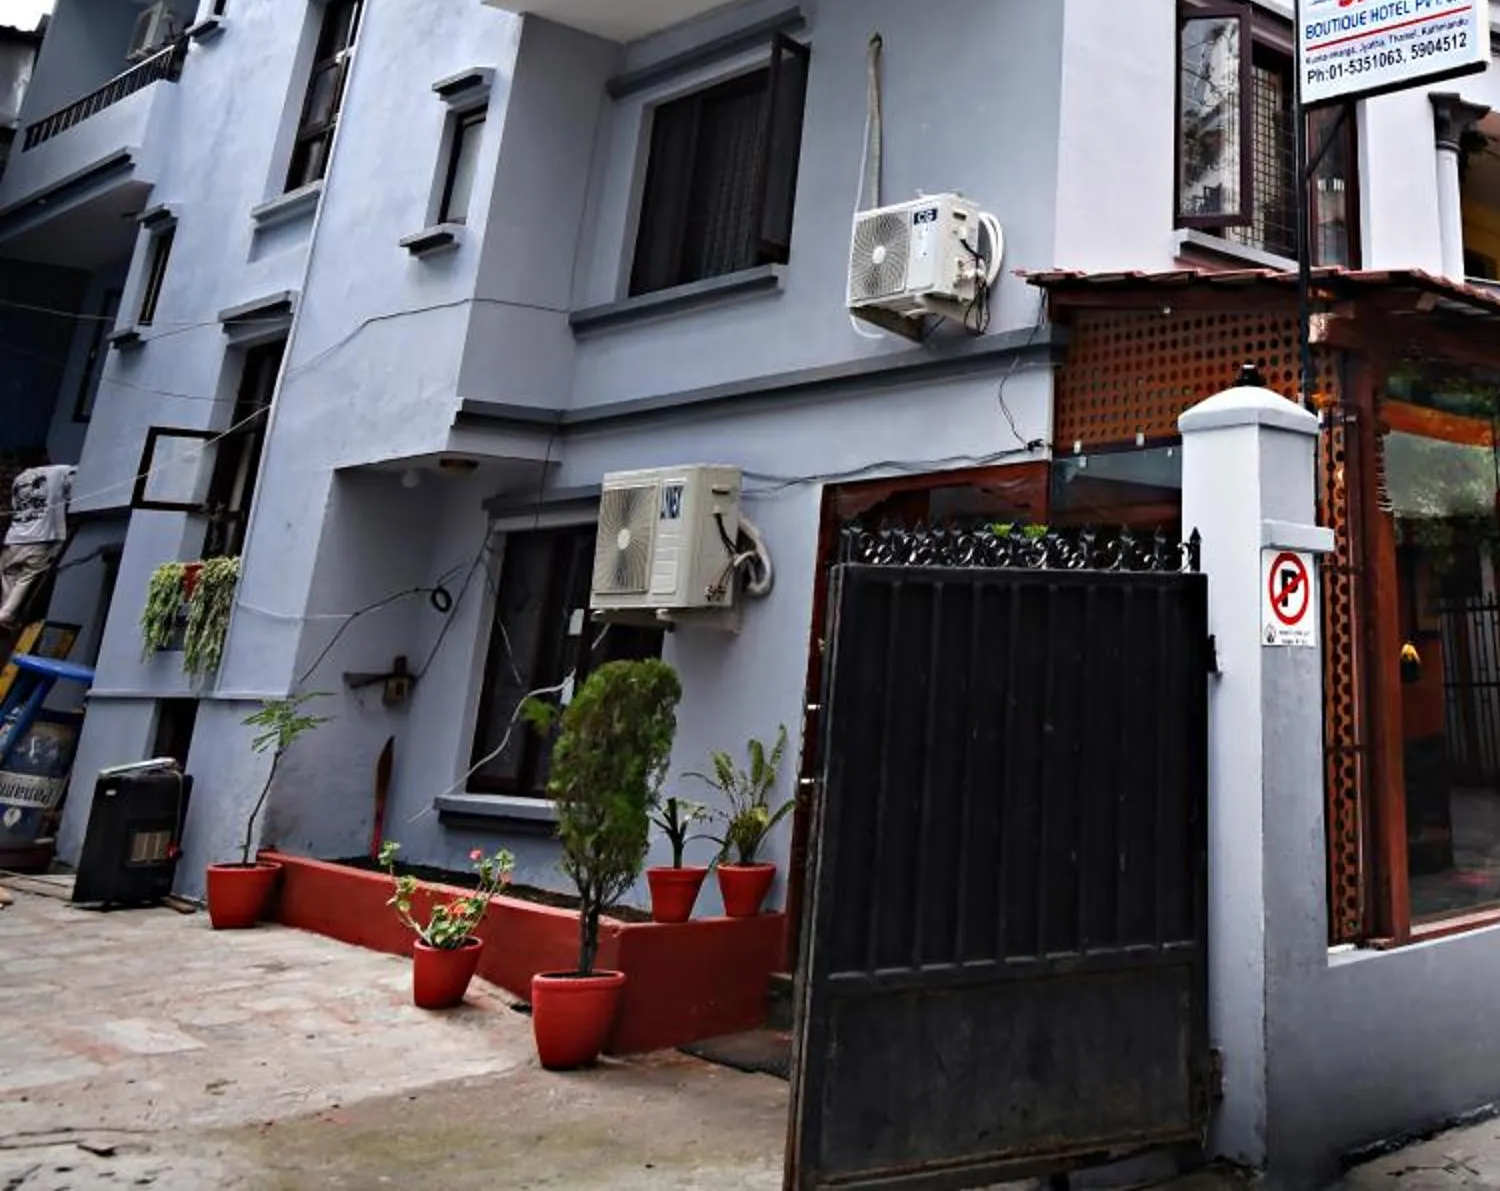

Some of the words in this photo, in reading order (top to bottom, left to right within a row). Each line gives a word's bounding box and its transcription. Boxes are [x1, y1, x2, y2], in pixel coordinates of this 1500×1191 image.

[1305, 11, 1367, 39] BOUTIQUE
[1370, 0, 1410, 22] HOTEL
[1411, 32, 1467, 59] 5904512
[1281, 569, 1298, 607] P
